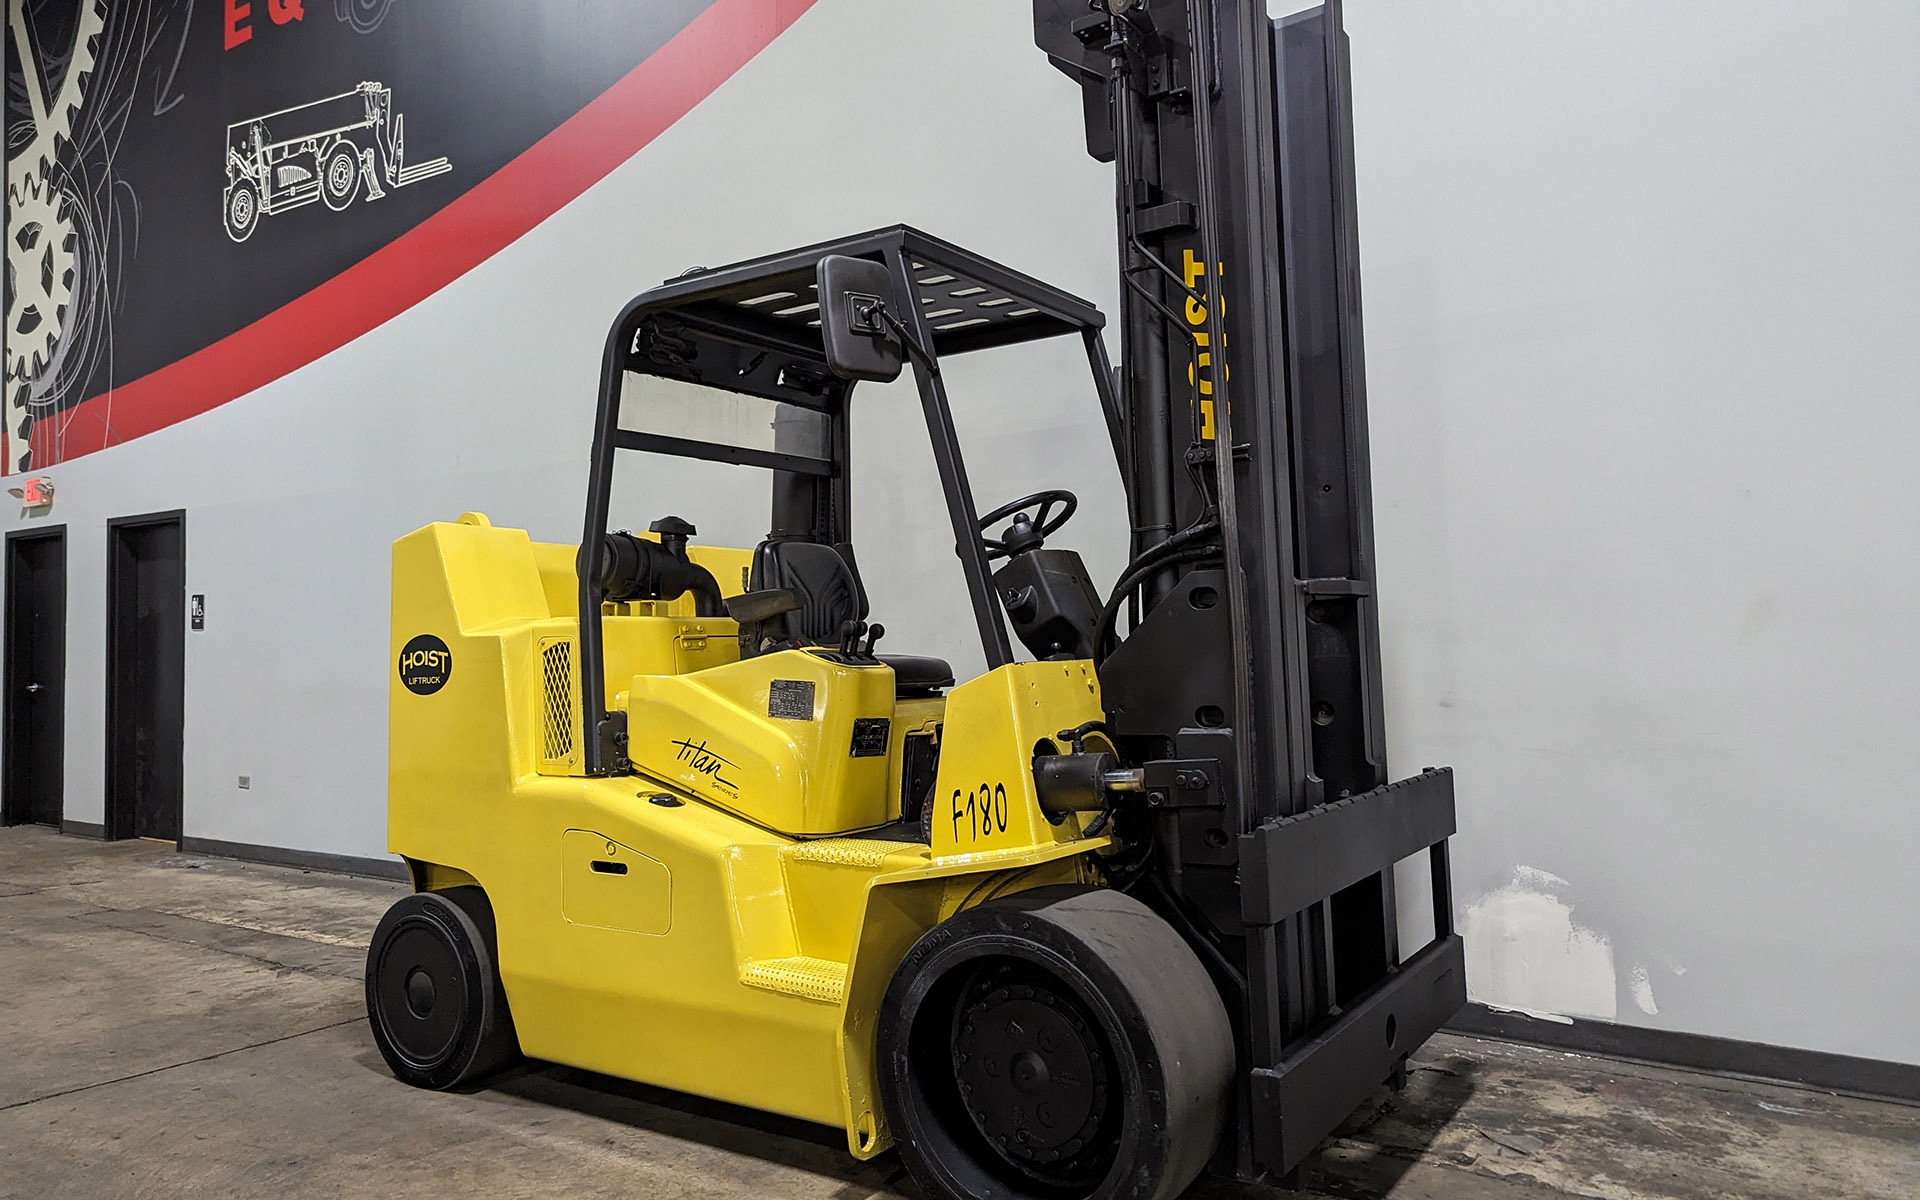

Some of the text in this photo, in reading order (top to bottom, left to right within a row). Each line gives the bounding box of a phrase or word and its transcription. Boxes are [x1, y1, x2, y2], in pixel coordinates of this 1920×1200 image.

[402, 650, 449, 676] HOIST
[408, 676, 441, 685] LIFTRUCK
[952, 781, 1008, 844] F180
